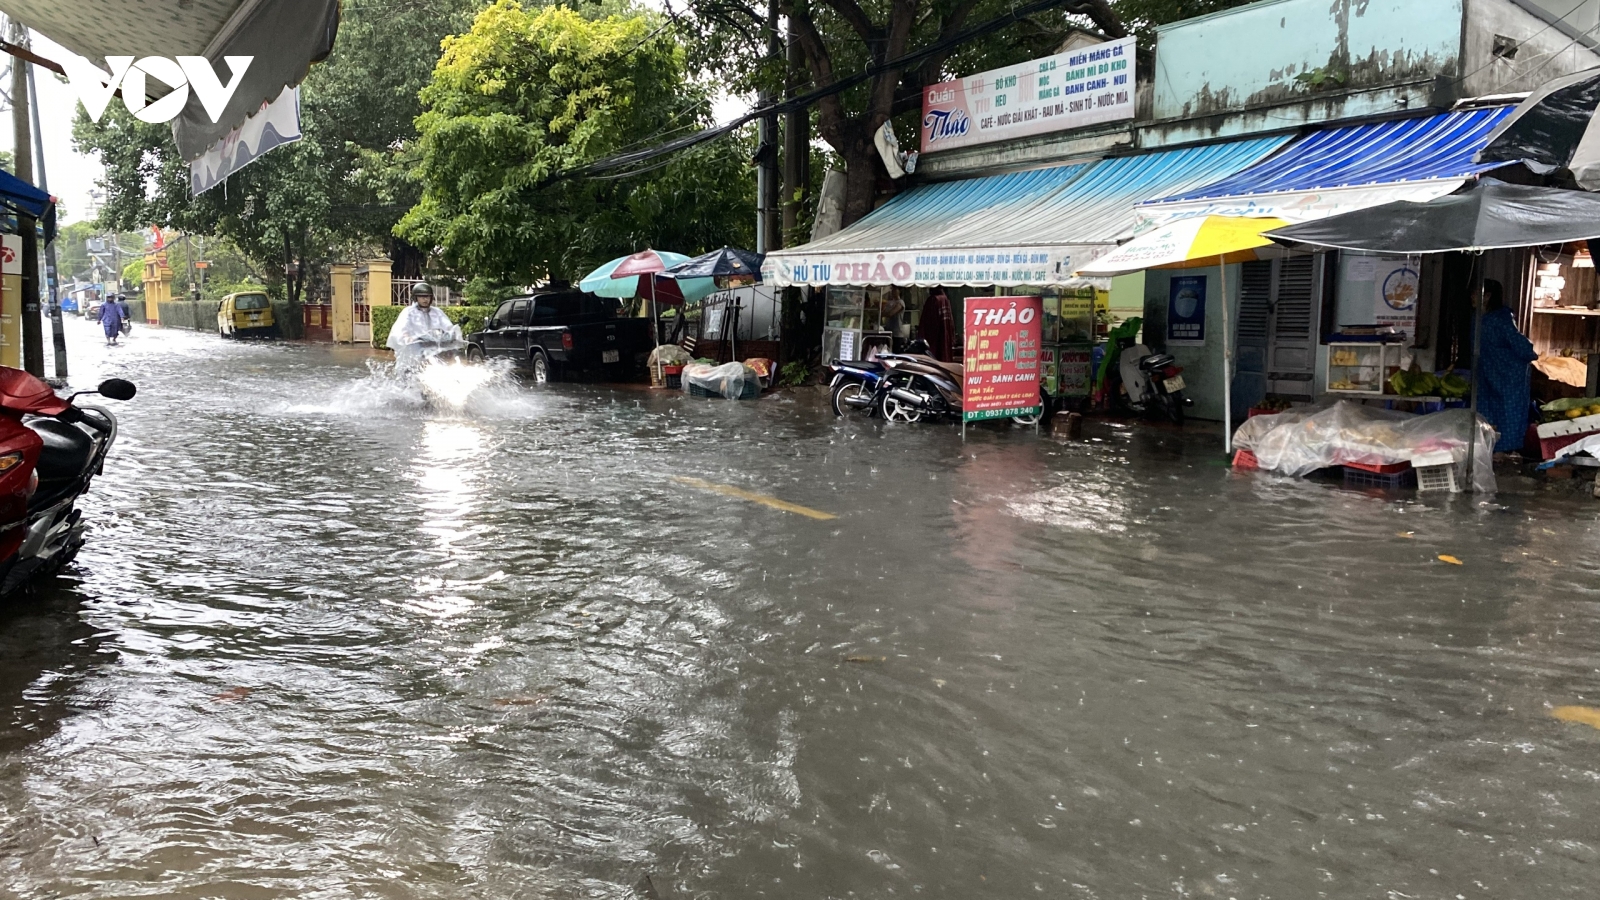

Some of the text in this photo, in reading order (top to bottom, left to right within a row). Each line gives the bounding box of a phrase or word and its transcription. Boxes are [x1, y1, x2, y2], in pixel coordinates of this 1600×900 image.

[1112, 44, 1123, 57] GÀ
[1066, 59, 1127, 82] BÁNH MÌ BÒ KHO
[1113, 74, 1127, 86] NUI
[1004, 74, 1017, 88] KHO
[928, 87, 955, 104] Quán
[995, 94, 1007, 107] HEO
[997, 111, 1011, 127] NƯỚC
[1024, 106, 1038, 121] KHÁT
[1043, 104, 1054, 118] RAU
[1054, 101, 1064, 115] MÁ
[1069, 98, 1083, 113] SINH
[1085, 93, 1093, 110] TỐ
[1097, 91, 1115, 108] NƯỚC
[1116, 88, 1129, 105] MÍA
[923, 107, 971, 143] Thảo
[793, 258, 808, 281] HỦ
[812, 260, 831, 281] TÍU
[835, 253, 912, 281] THẢO
[973, 301, 1035, 326] THẢO
[1004, 335, 1016, 362] BÚN
[968, 373, 1036, 385] NUI BÁNH CANH
[985, 409, 1003, 417] 0937
